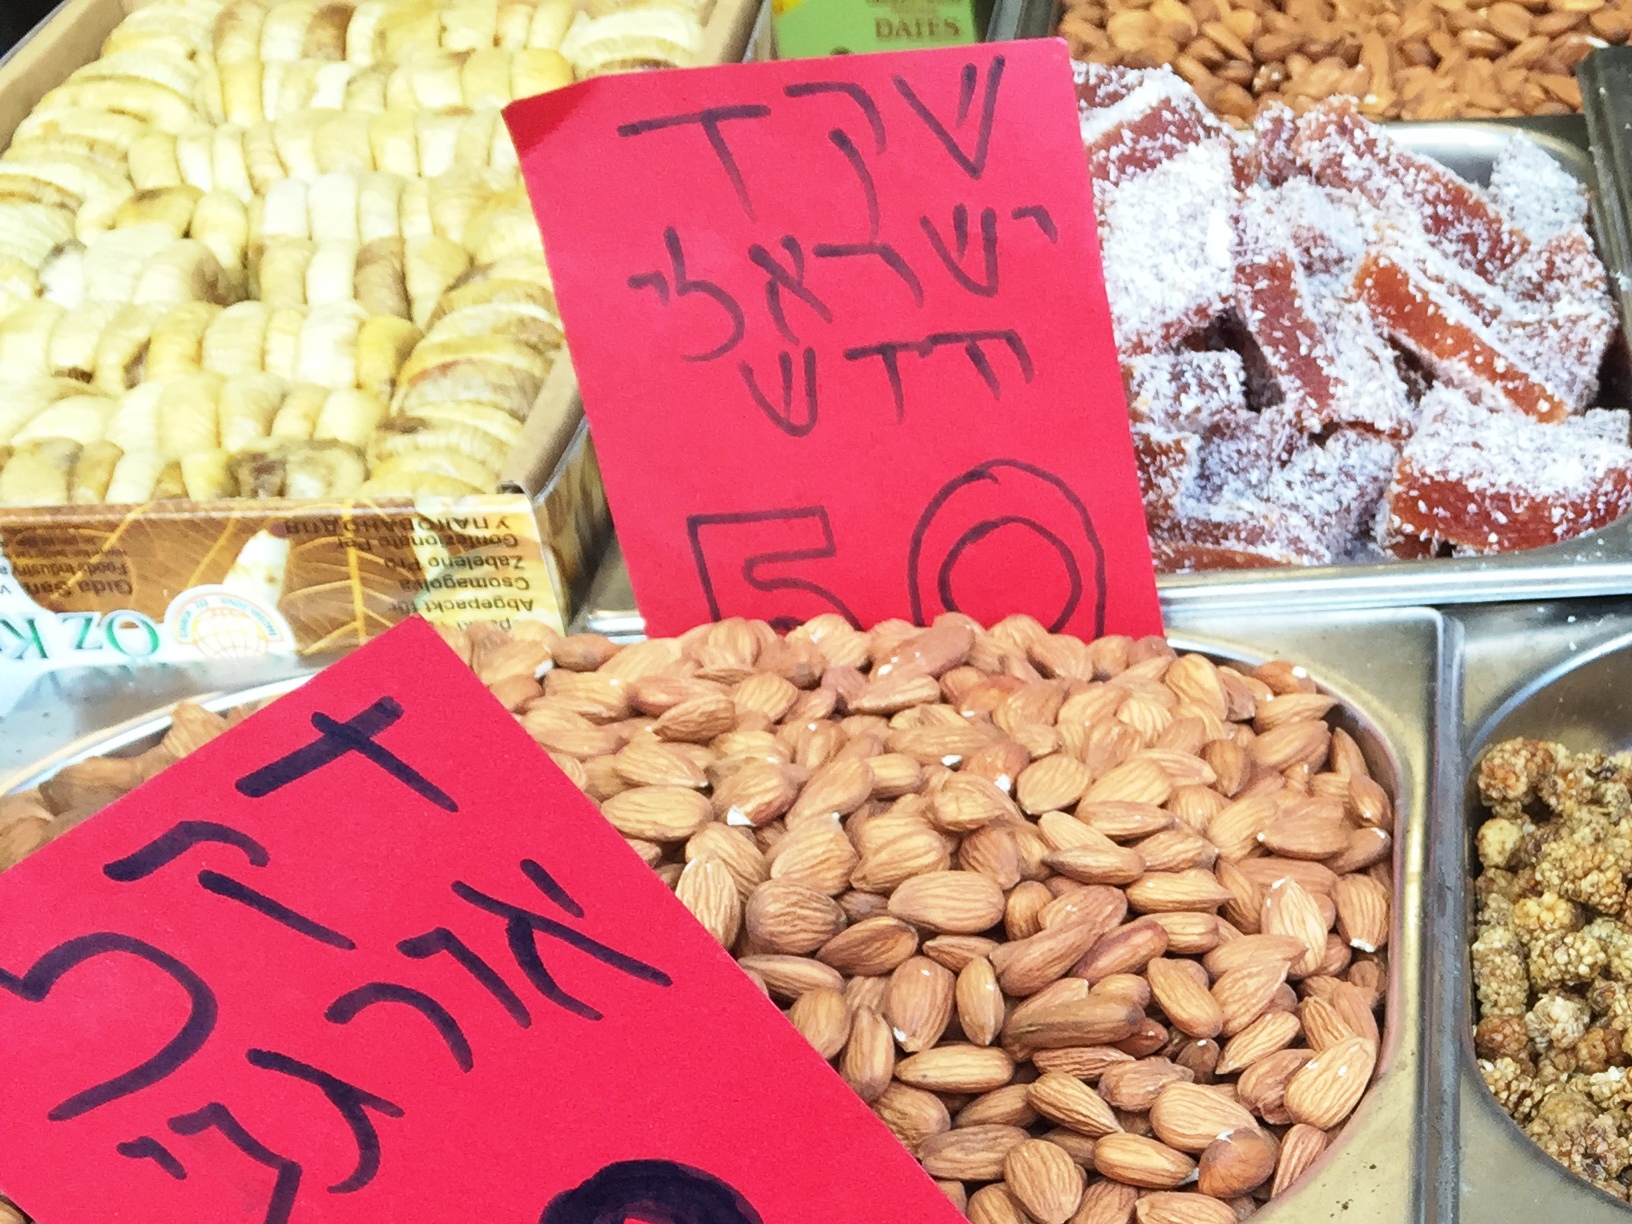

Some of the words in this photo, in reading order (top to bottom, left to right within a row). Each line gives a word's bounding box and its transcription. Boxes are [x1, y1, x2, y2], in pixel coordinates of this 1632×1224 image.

[617, 55, 1005, 240] שקד
[627, 203, 1058, 363] ישראלי
[740, 328, 1035, 437] חדש
[400, 575, 530, 593] Csomagolva
[426, 597, 534, 613] Abgepackt
[687, 458, 1106, 639] 50
[0, 695, 458, 1121] דקל
